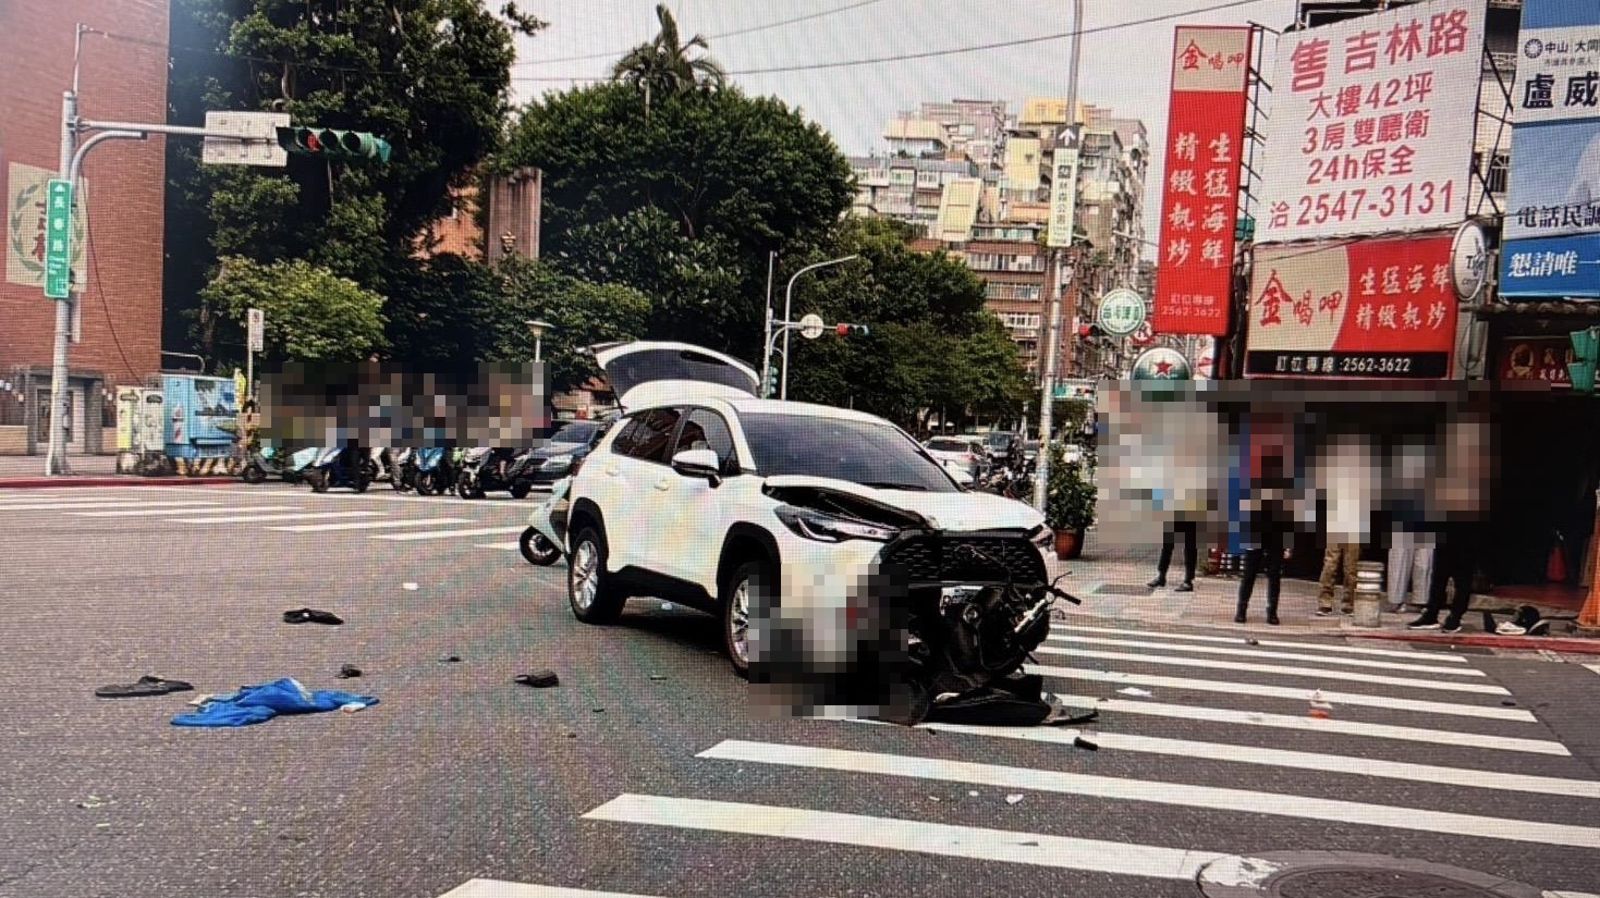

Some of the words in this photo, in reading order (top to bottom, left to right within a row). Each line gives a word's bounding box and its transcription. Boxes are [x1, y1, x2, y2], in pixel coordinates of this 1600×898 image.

[1291, 38, 1330, 93] 售
[1344, 9, 1468, 75] 吉林路
[1544, 41, 1568, 53] 中山
[1306, 71, 1433, 121] 大樓42坪
[1522, 70, 1600, 108] 盧威
[1302, 109, 1430, 154] 3房雙廳衛
[1306, 144, 1415, 185] 24h保全
[1200, 132, 1232, 268] 生猛海鮮
[1268, 201, 1290, 229] 洽
[1296, 180, 1453, 225] 2547-3131
[1518, 203, 1600, 228] 電話民調
[1359, 263, 1451, 296] 生猛海鮮
[1508, 250, 1600, 277] 懇請唯一
